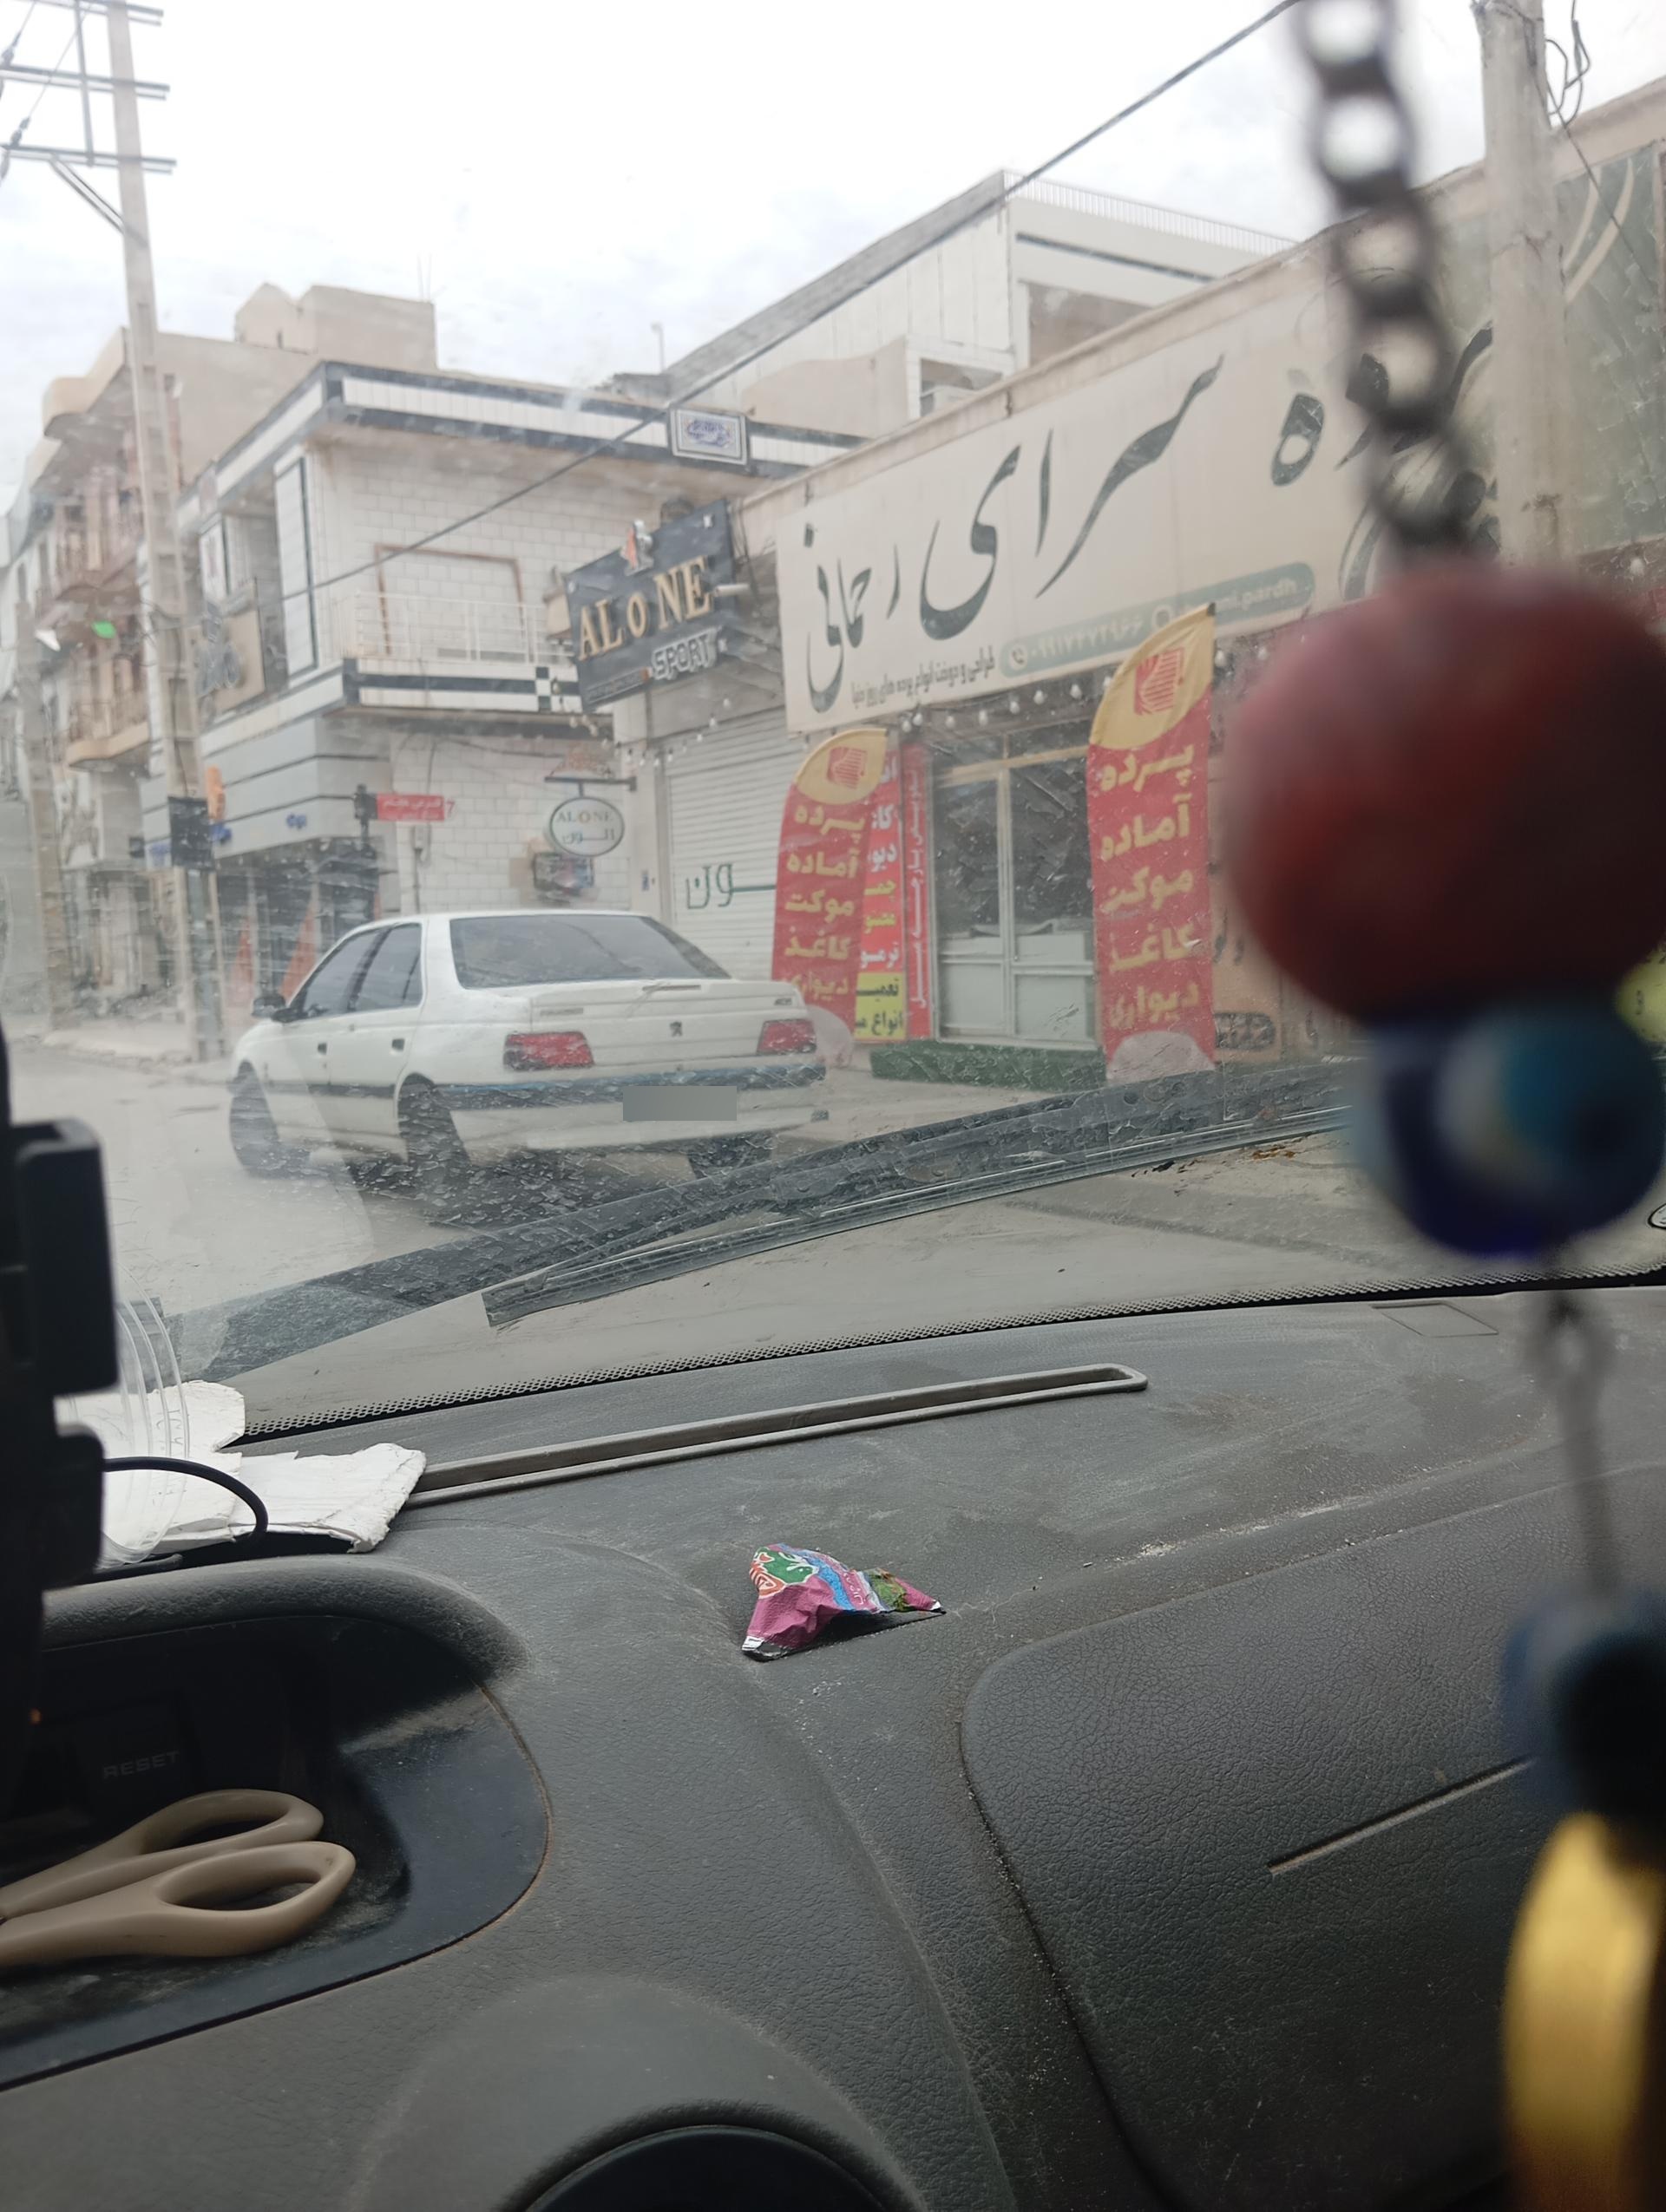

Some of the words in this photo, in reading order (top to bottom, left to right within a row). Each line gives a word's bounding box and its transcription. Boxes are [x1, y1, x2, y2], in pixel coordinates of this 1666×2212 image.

[919, 355, 1224, 639] سرای
[653, 627, 721, 680] SPORT
[1100, 744, 1194, 793] پرده
[795, 805, 866, 845] پرده
[1102, 792, 1193, 861] آماده
[786, 847, 860, 880] آماده
[785, 889, 855, 924] موکت
[1102, 867, 1194, 911] موکت
[785, 926, 851, 959] کاغذ
[1109, 921, 1196, 973] کاغذ
[1109, 981, 1199, 1029] دیواری
[102, 1751, 180, 1779] RESET
